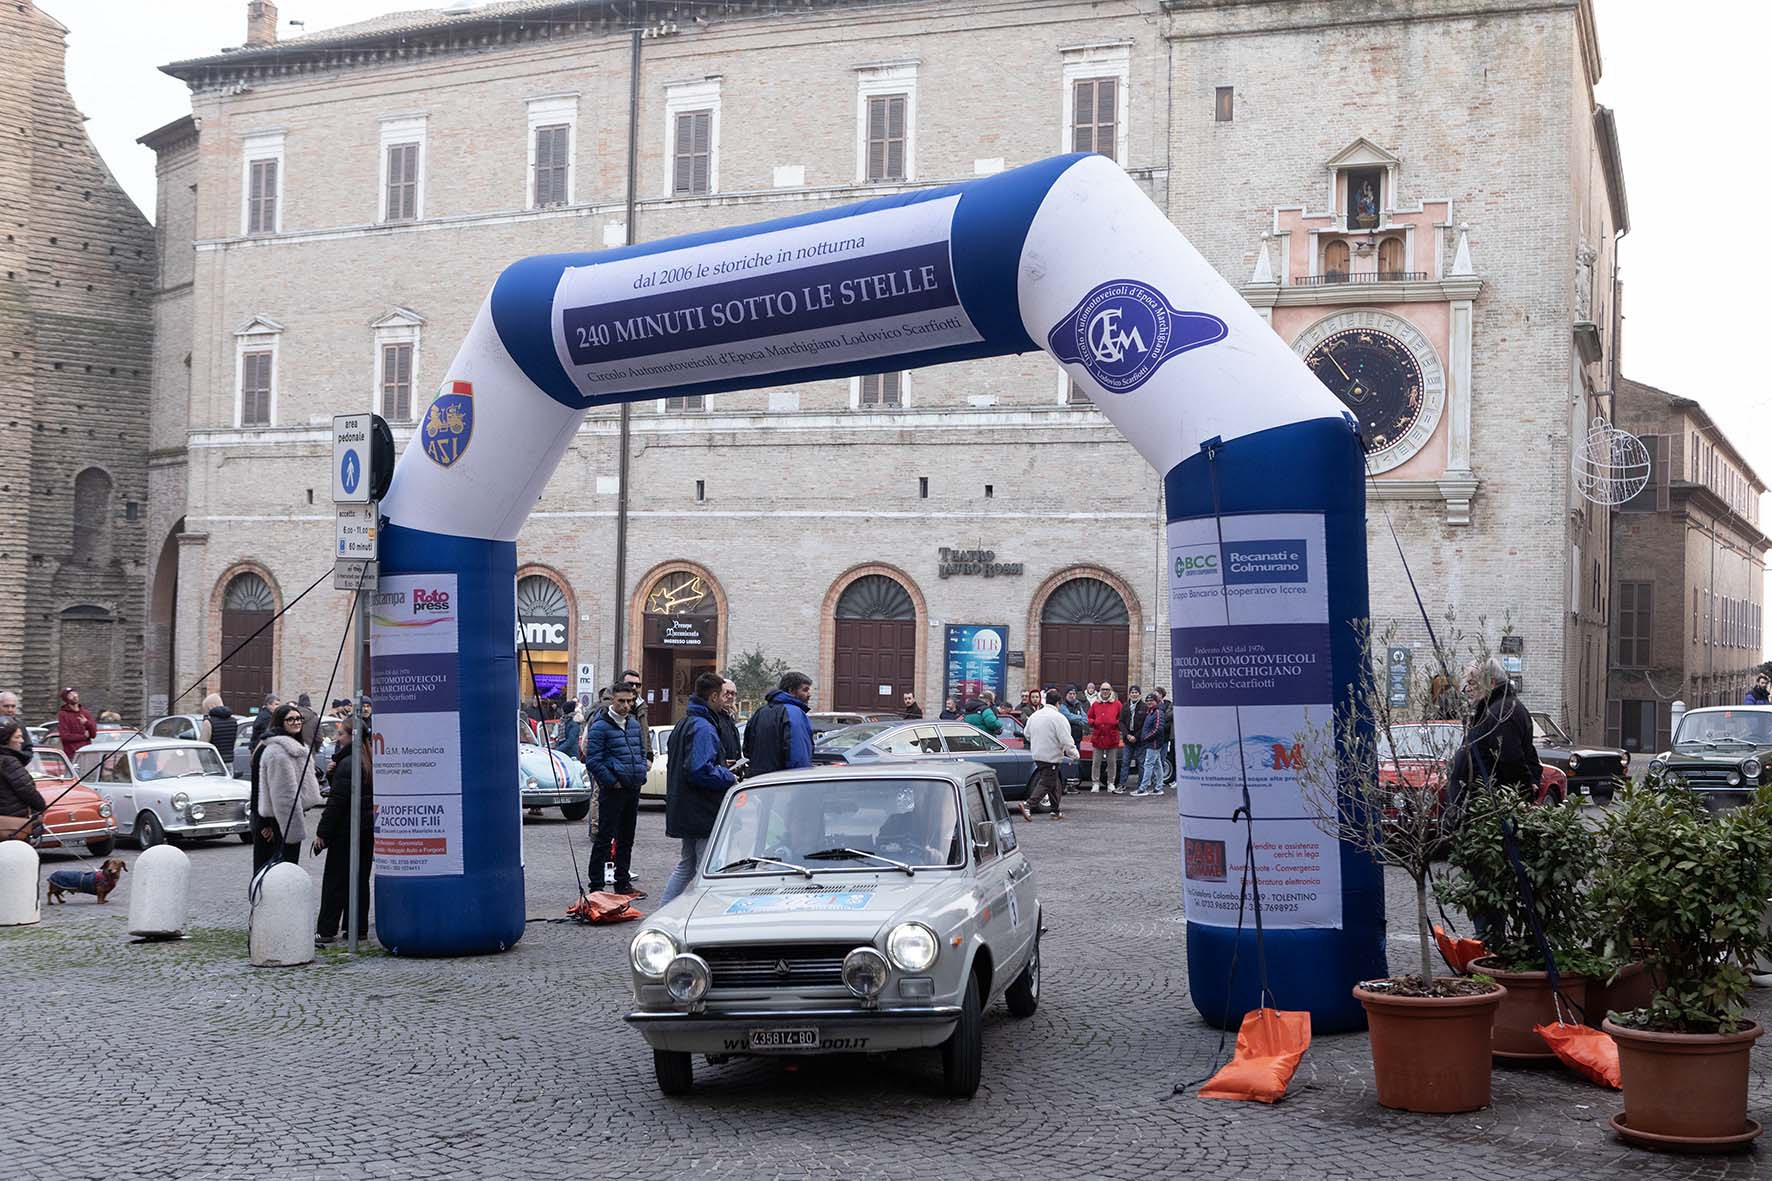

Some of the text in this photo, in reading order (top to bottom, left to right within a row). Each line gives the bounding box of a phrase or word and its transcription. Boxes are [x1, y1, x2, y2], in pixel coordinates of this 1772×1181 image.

[633, 237, 866, 289] dal 2006 le storiche in notturna
[576, 265, 938, 348] 240 MINUTI SOTTO LE STELLE
[1078, 286, 1168, 368] Circolo Automotoveicoli d'Epoca Marchigiano
[587, 316, 962, 383] Circolo Automotoveicoli d'Epoca Marchigiano Lodovico Scarfiotti
[1122, 365, 1149, 386] Scarfiotti
[345, 420, 358, 429] area
[338, 431, 365, 444] pedonale
[1185, 550, 1299, 570] BCC Recanati e
[1230, 562, 1300, 572] Colmurano
[413, 588, 450, 602] Roto
[1189, 588, 1219, 599] Bancario
[1220, 585, 1277, 597] Cooperativo
[1280, 586, 1306, 594] Iccrea
[413, 602, 450, 614] press
[1200, 654, 1316, 666] AUTOMOTOVEICOLI
[1212, 666, 1302, 678] MARCHIGIANO
[1191, 678, 1275, 690] Lodovico Scarfiotti
[402, 746, 445, 754] Meccanica
[381, 804, 445, 815] AUTOFFICINA
[381, 817, 419, 826] ZACCONI
[1274, 850, 1295, 858] cerchi
[1304, 850, 1320, 860] lega
[1276, 864, 1320, 874] Convergenza
[1285, 877, 1320, 886] elettronica
[1272, 892, 1317, 900] TOLENTINO
